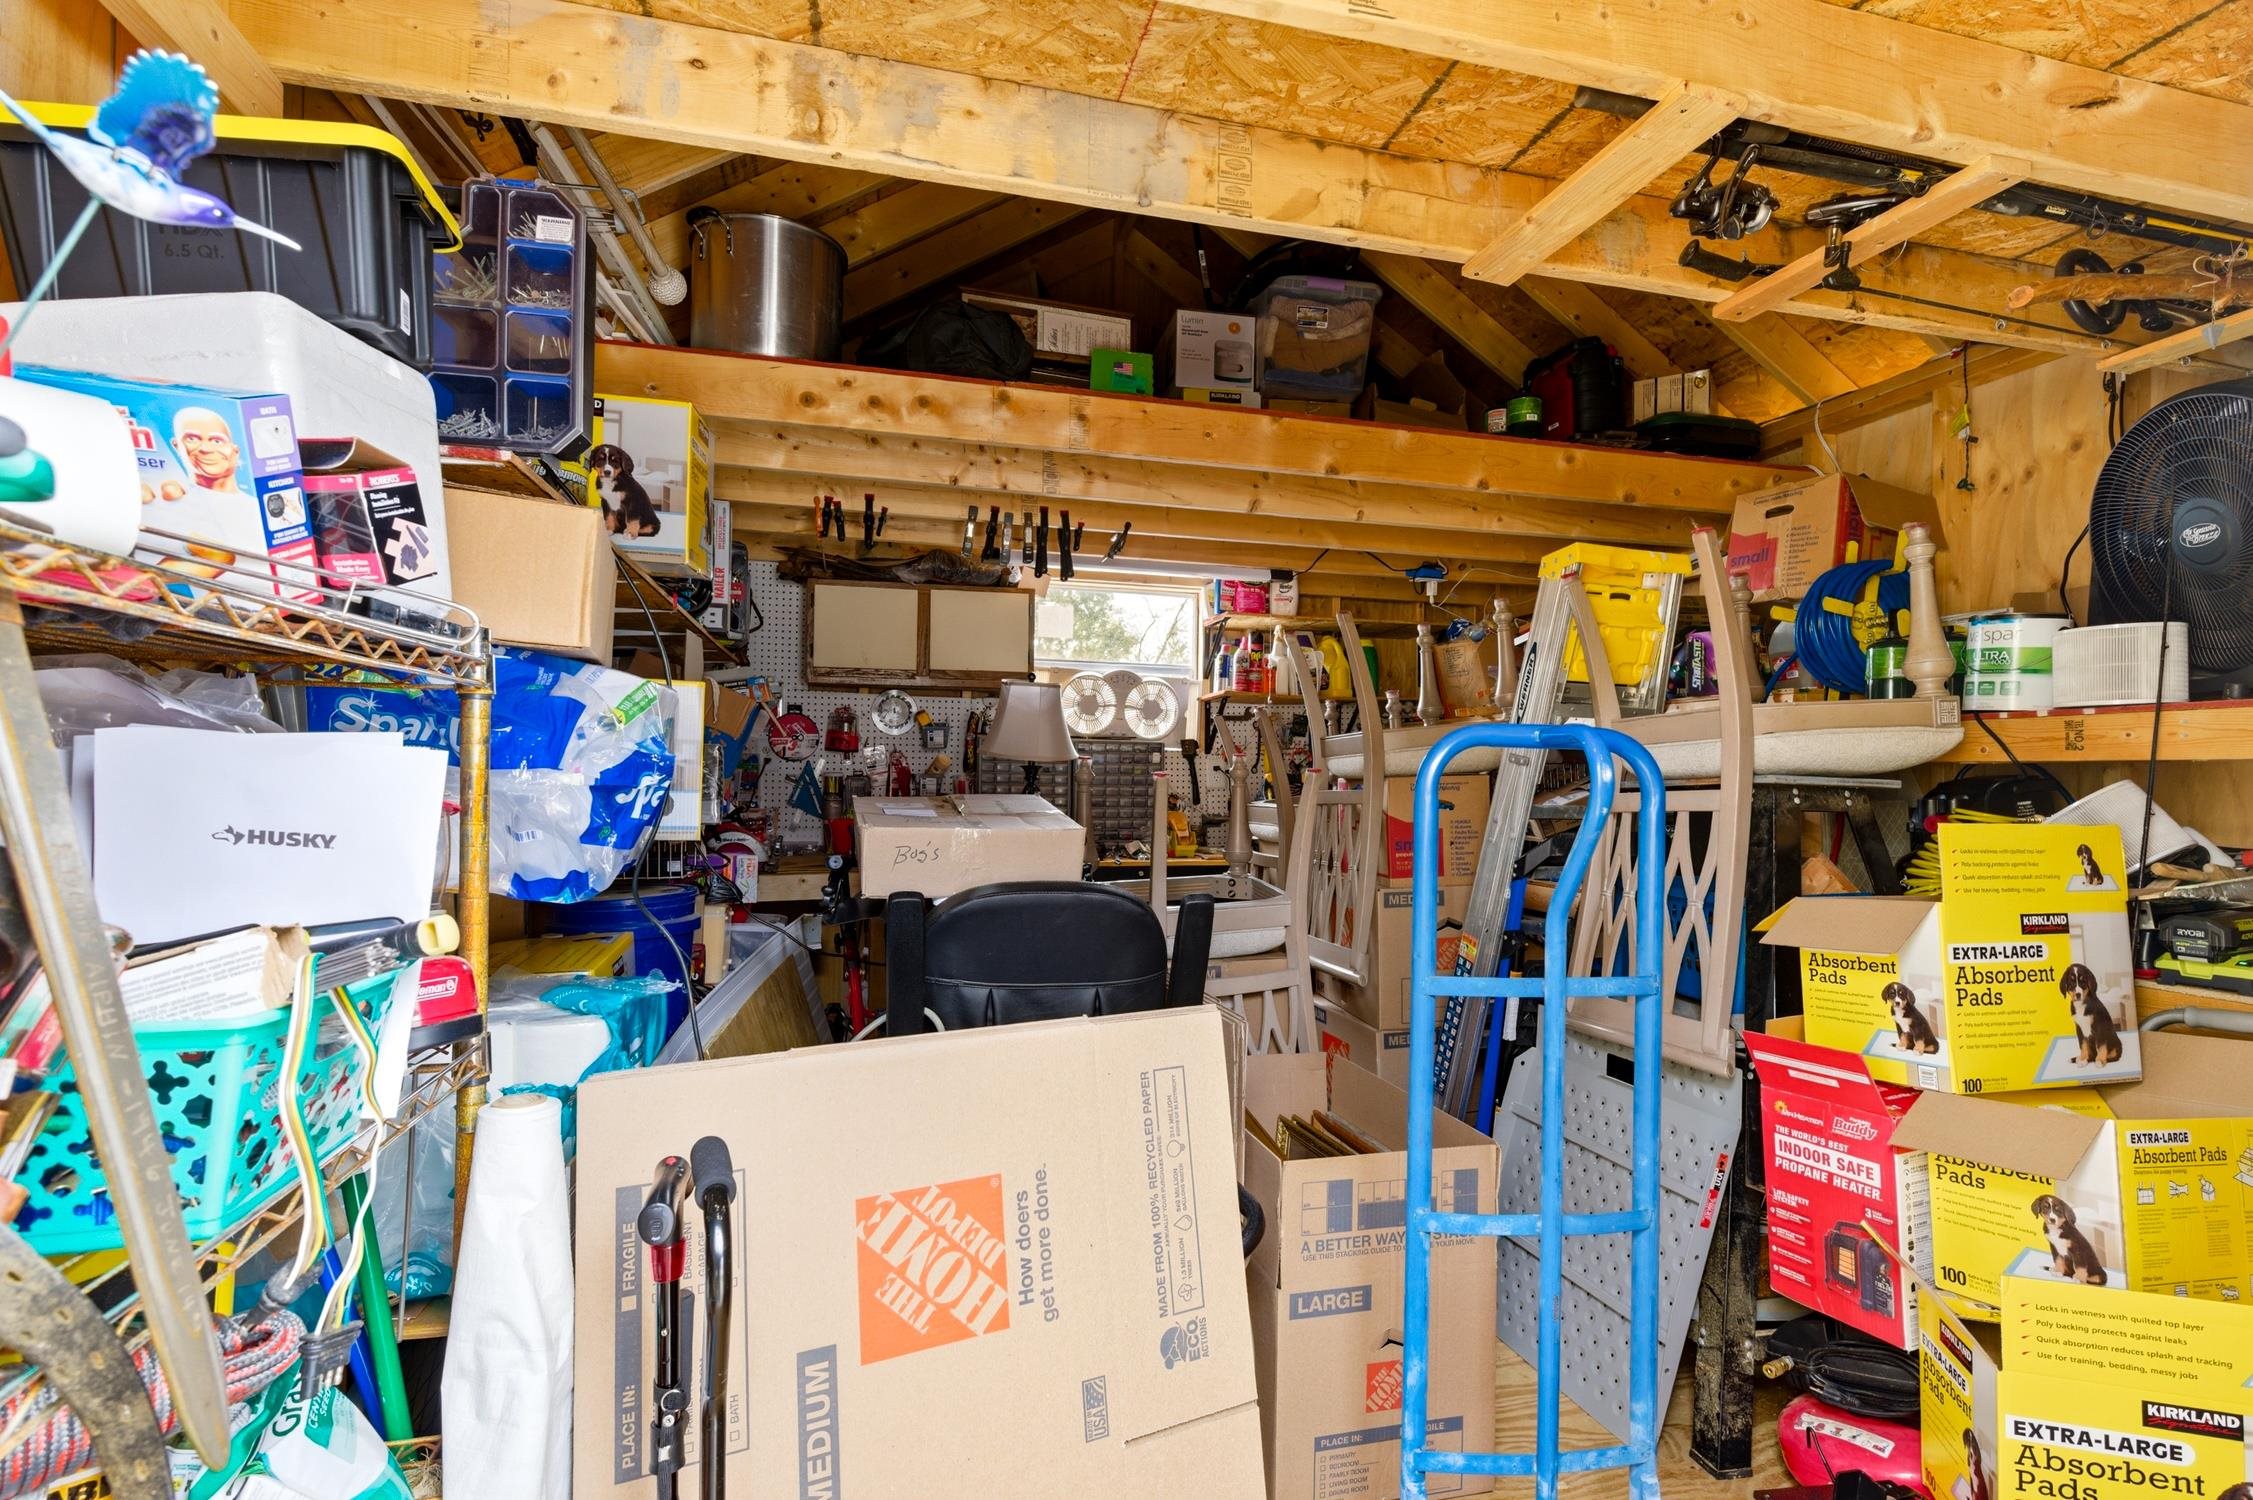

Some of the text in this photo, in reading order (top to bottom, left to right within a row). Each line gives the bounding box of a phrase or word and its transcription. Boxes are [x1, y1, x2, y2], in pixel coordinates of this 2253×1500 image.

[164, 243, 224, 259] 6.5 Qt.
[1730, 548, 1770, 568] small
[1519, 654, 1535, 711] WERNER
[247, 828, 337, 850] HUSKY
[2023, 915, 2068, 926] KIRKLAND
[2177, 928, 2205, 938] RYOBI
[1808, 953, 1897, 975] Absorbent
[1953, 944, 2043, 960] EXTRA-LARGE
[1809, 968, 1847, 985] Pads
[1955, 965, 2055, 985] Absorbent
[1956, 988, 2004, 1007] Pads
[1962, 1078, 1982, 1093] 100
[1775, 1124, 1790, 1135] THE
[1791, 1129, 1826, 1146] WORLD'S
[1828, 1140, 1849, 1153] BEST
[1834, 1117, 1877, 1141] Buddy
[2131, 1132, 2189, 1144] EXTRA-LARGE
[1779, 1139, 1875, 1181] INDOOR SAFE
[2133, 1146, 2228, 1165] Absorbent Pads
[1775, 1157, 1882, 1200] PROPANE HEATER
[1935, 1164, 1986, 1190] Pads
[1140, 1071, 1170, 1319] MADE FROM 100% RECYCLED PAPER
[1864, 1207, 1872, 1218] 3
[911, 1185, 1007, 1269] DEPOT
[621, 1221, 636, 1290] FRAGILE
[1016, 1190, 1034, 1306] How doers
[1034, 1163, 1059, 1323] get more done.
[1300, 1231, 1406, 1255] A BETTER WAY
[856, 1191, 1009, 1336] HOME
[1303, 1253, 1317, 1262] USE
[1940, 1265, 1967, 1286] 100
[875, 1271, 937, 1336] THE
[1297, 1290, 1364, 1314] LARGE
[2035, 1303, 2205, 1332] Locks in wetness with quilted top layer
[1200, 1316, 1209, 1358] ACTIONS
[2036, 1319, 2188, 1346] Poly backing protects against leaks
[1921, 1333, 1967, 1392] EXTRA-LARGE
[2036, 1335, 2233, 1370] Quick absorption reduces splash and tracking
[2037, 1351, 2199, 1381] Use for training, bedding, messy jobs
[1922, 1352, 1973, 1421] Absorbent
[1922, 1368, 1945, 1406] Pads
[730, 1393, 739, 1424] BATH
[1093, 1408, 1107, 1437] USA
[2147, 1403, 2241, 1429] KIRKLAND
[621, 1384, 636, 1469] PLACE IN:
[804, 1361, 834, 1500] MEDIUM
[2013, 1419, 2183, 1462] EXTRA-LARGE
[1320, 1434, 1363, 1448] PLACE IN:
[1349, 1477, 1368, 1485] ROOM
[2014, 1444, 2206, 1497] Absorbent
